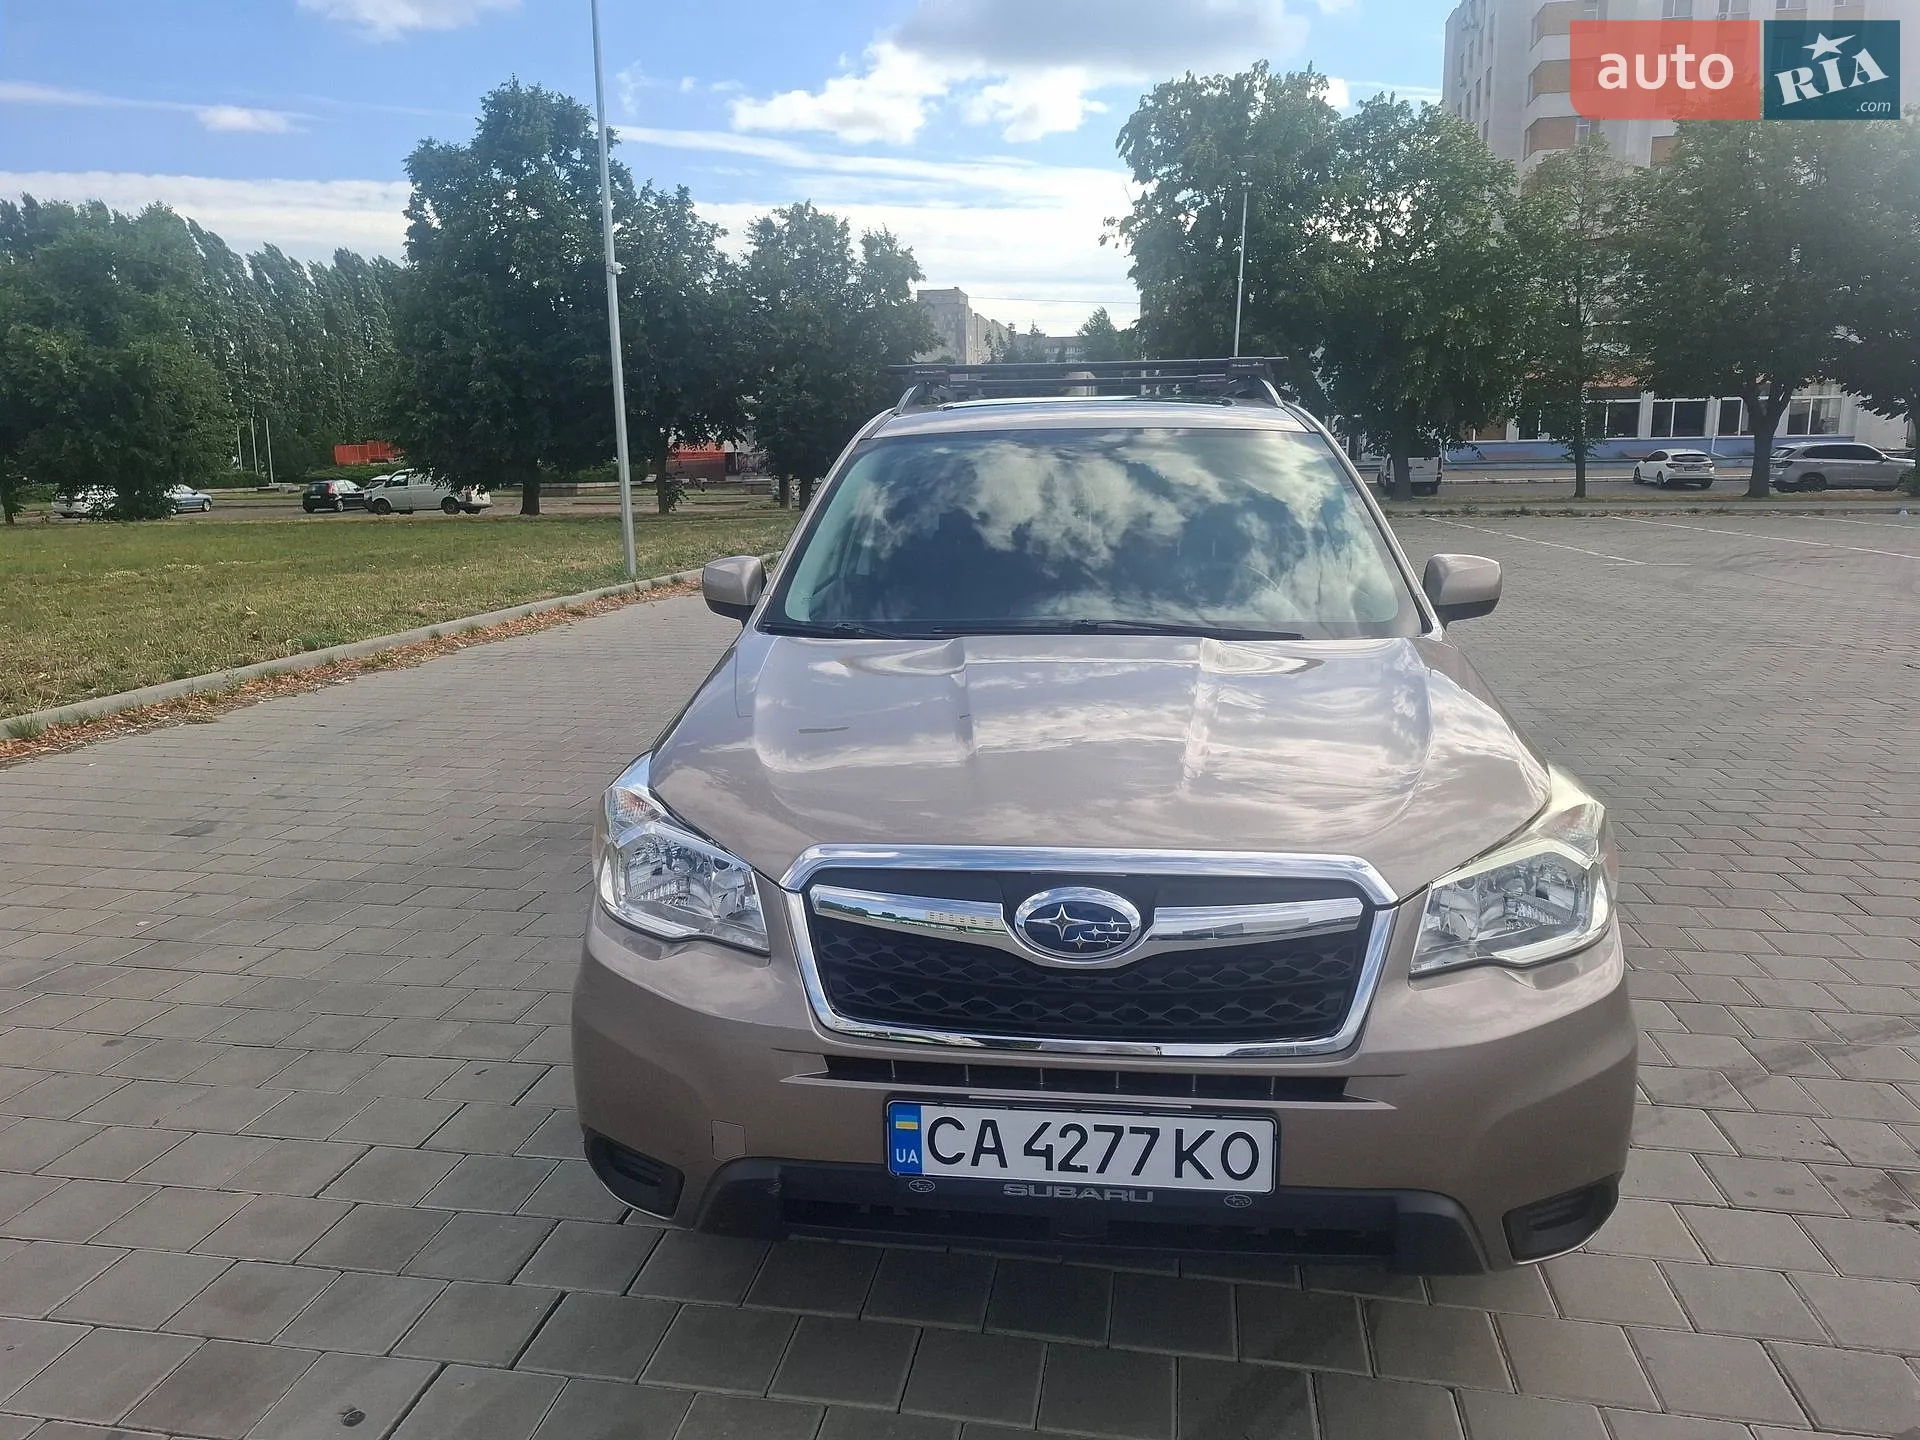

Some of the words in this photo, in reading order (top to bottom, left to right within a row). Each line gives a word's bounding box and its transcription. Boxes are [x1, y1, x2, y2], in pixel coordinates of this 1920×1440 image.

[895, 1147, 919, 1164] UA
[927, 1116, 1009, 1169] CA
[1023, 1121, 1161, 1177] 4277
[1174, 1128, 1260, 1181] KO
[1002, 1183, 1154, 1203] SUBARU
